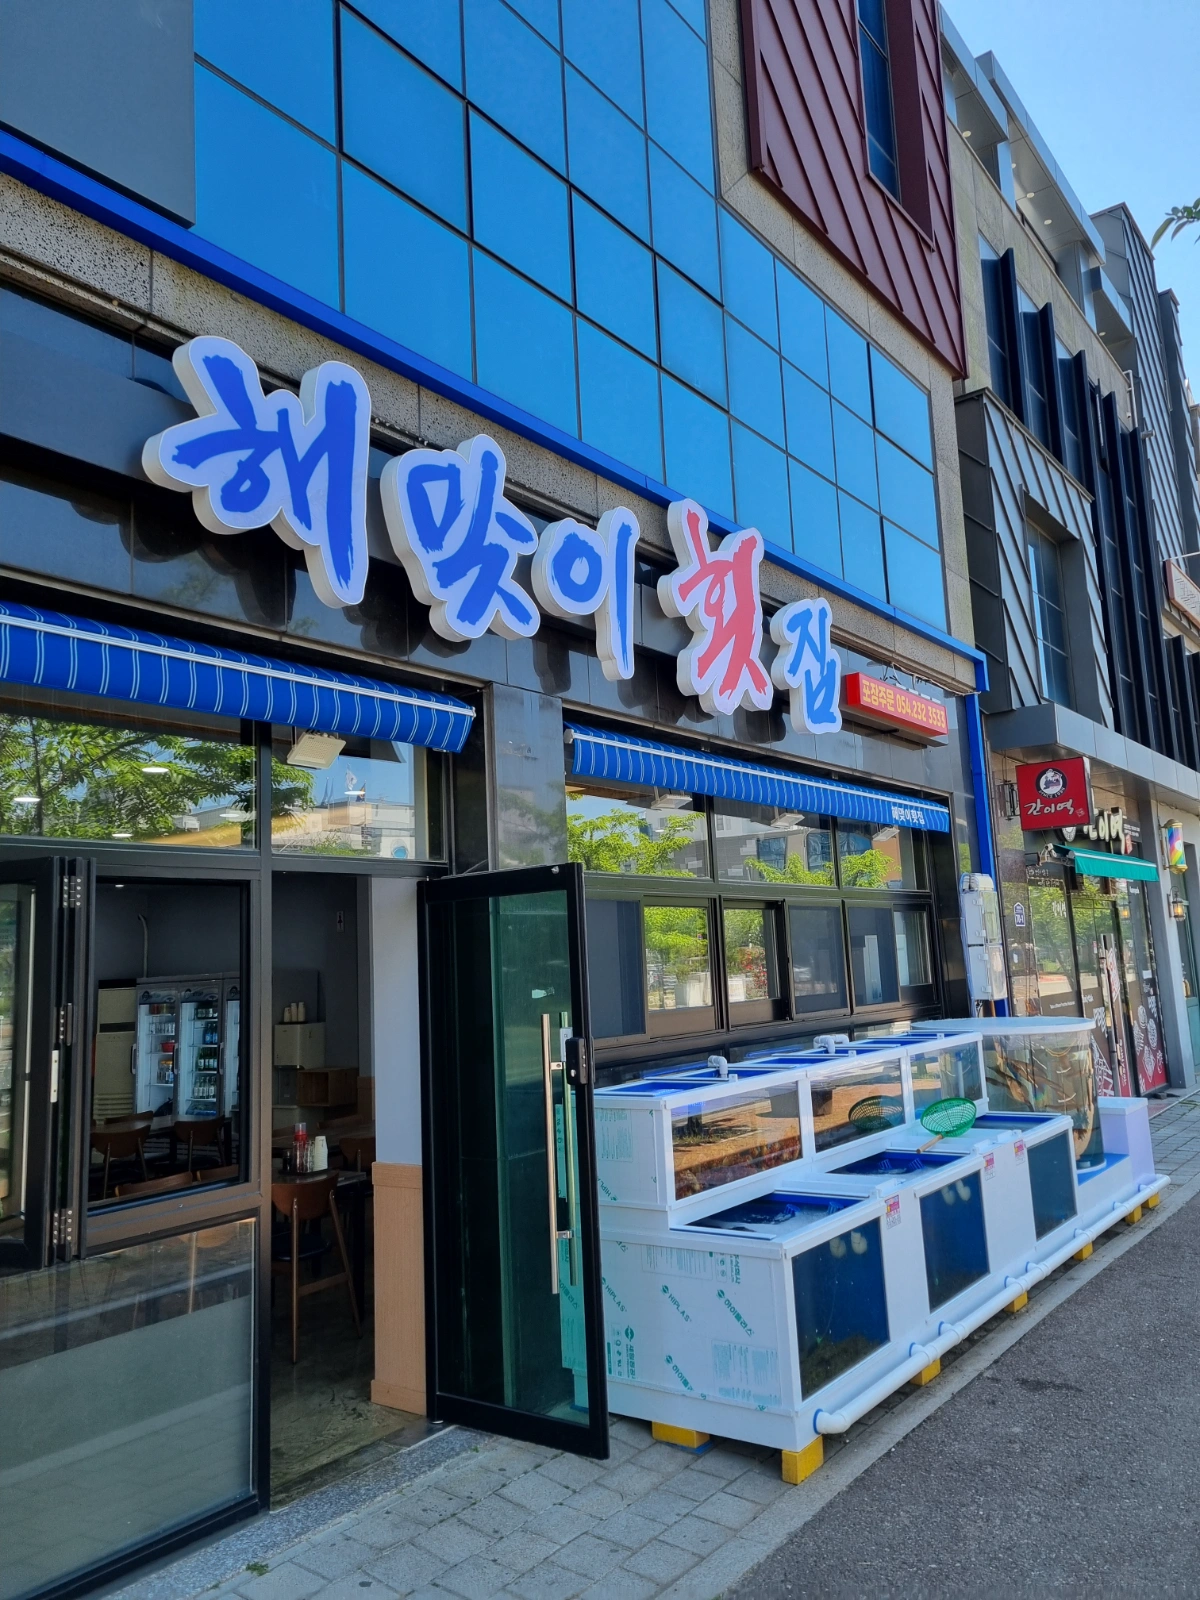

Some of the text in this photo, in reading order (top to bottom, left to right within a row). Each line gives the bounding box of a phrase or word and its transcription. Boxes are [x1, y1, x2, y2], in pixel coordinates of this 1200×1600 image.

[862, 680, 895, 711] 포장주문
[891, 806, 926, 825] 해맞이횟집
[1023, 799, 1074, 815] 간이역
[604, 1285, 626, 1312] HIPLAS
[668, 1294, 690, 1322] HIPLAS
